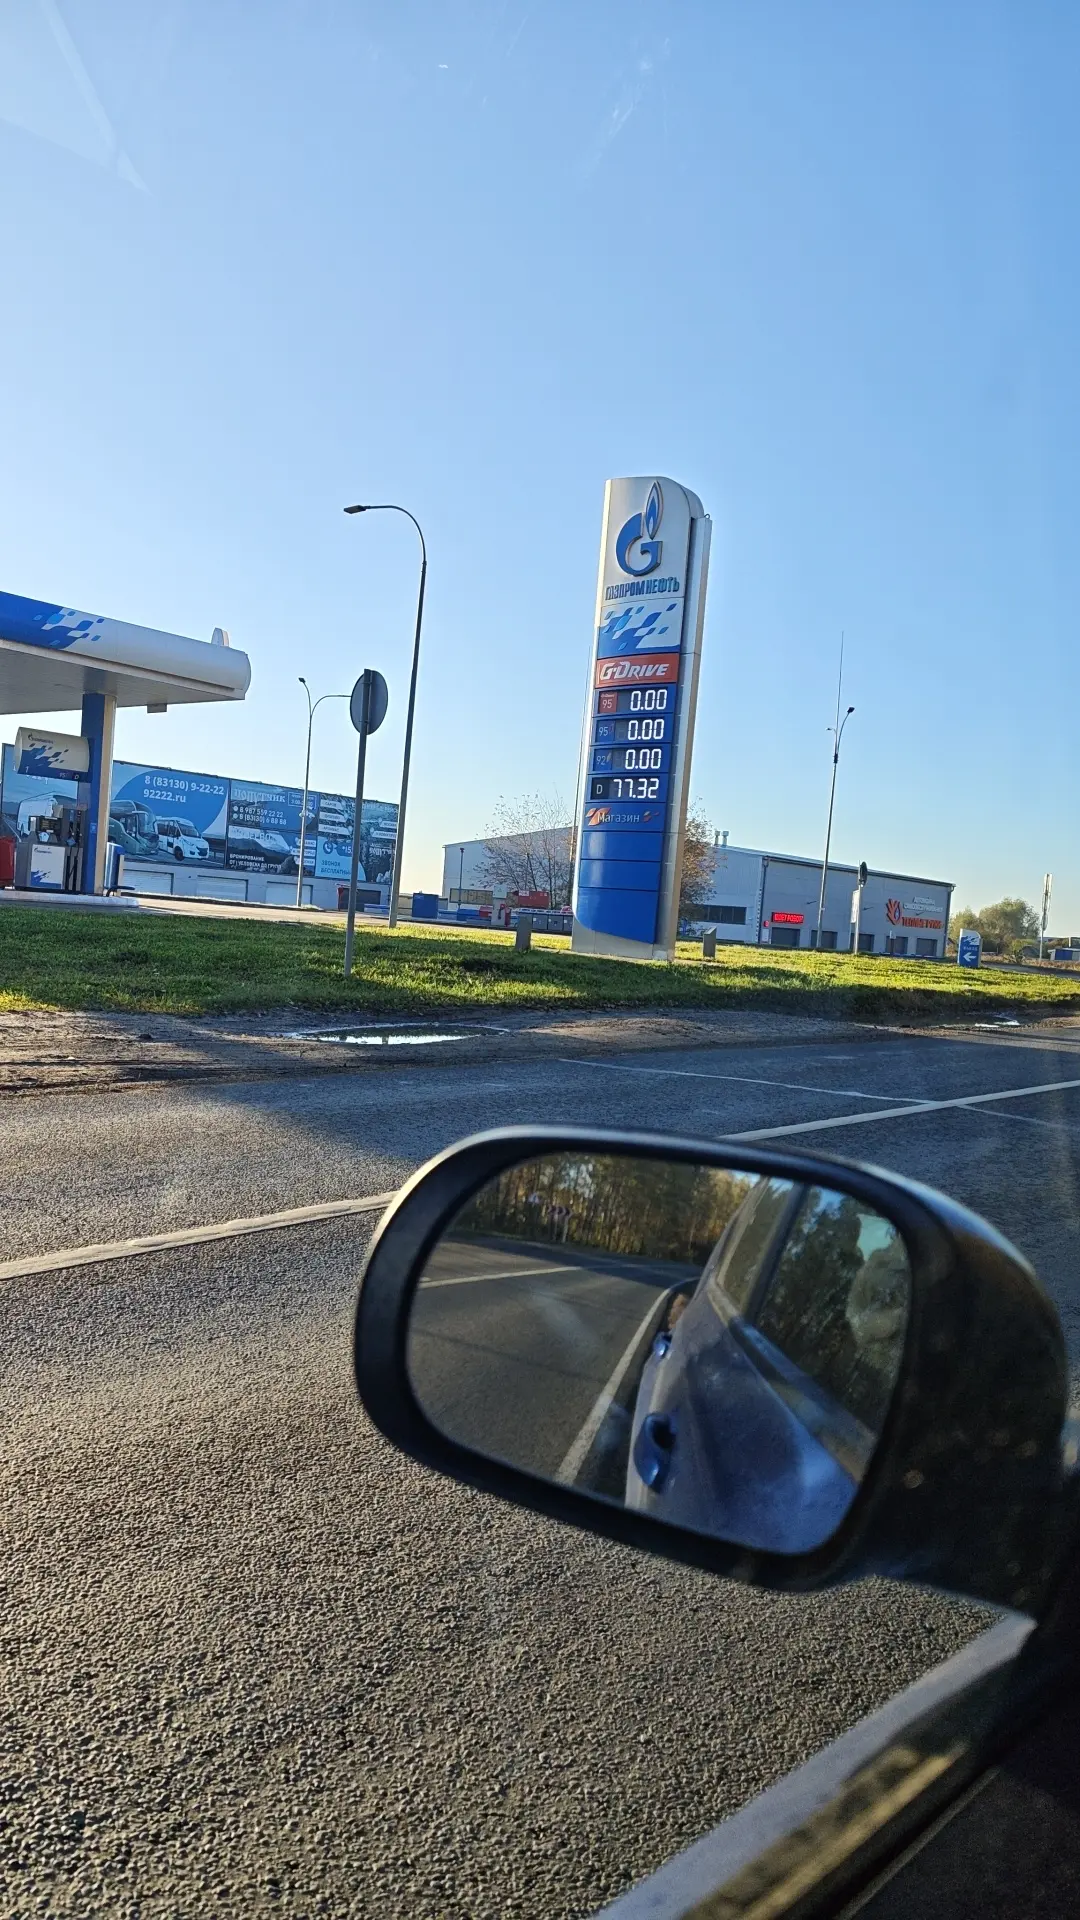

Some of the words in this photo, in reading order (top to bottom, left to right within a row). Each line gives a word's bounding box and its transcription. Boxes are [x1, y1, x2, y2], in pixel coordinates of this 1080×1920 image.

[605, 577, 680, 601] ГАЗПРОМНЕФТЬ
[602, 699, 613, 709] 95
[630, 689, 667, 711] 0.00
[598, 727, 608, 737] 95
[627, 719, 664, 740] 0.00
[596, 755, 606, 765] 92
[625, 748, 662, 770] 0.00
[143, 789, 186, 803] 92222.ru
[144, 775, 151, 784] 8
[152, 776, 189, 791] (83130)
[190, 783, 224, 796] 9-22-22
[596, 784, 603, 794] D
[613, 778, 659, 799] 77.32
[597, 812, 640, 823] Магазин
